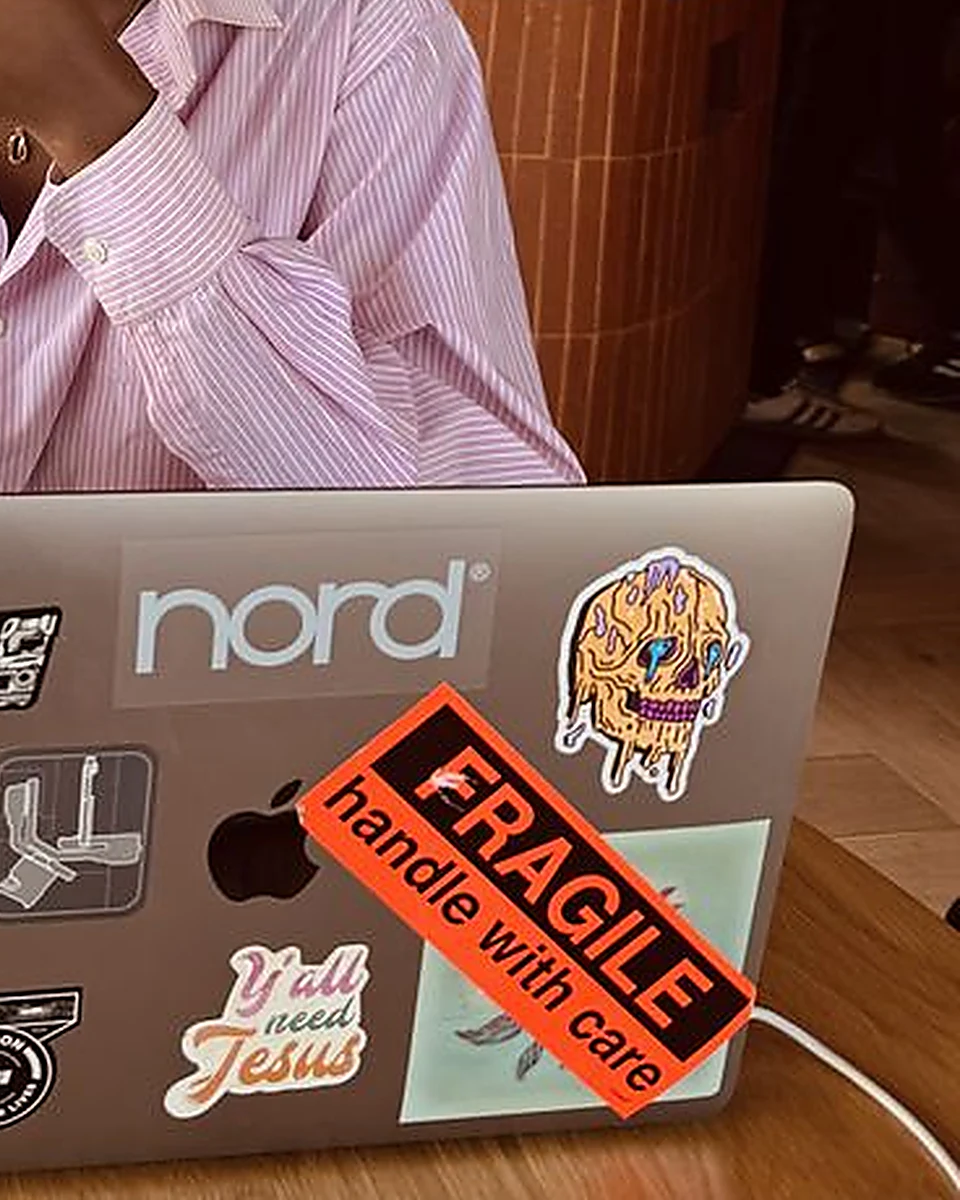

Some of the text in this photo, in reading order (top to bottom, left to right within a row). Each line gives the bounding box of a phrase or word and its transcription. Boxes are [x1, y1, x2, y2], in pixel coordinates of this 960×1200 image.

[136, 560, 465, 673] nord
[323, 774, 662, 1092] handle with care
[414, 745, 714, 1029] FRAGILE
[236, 950, 363, 1018] Y'all
[265, 997, 354, 1035] need
[186, 1023, 361, 1103] Jesus
